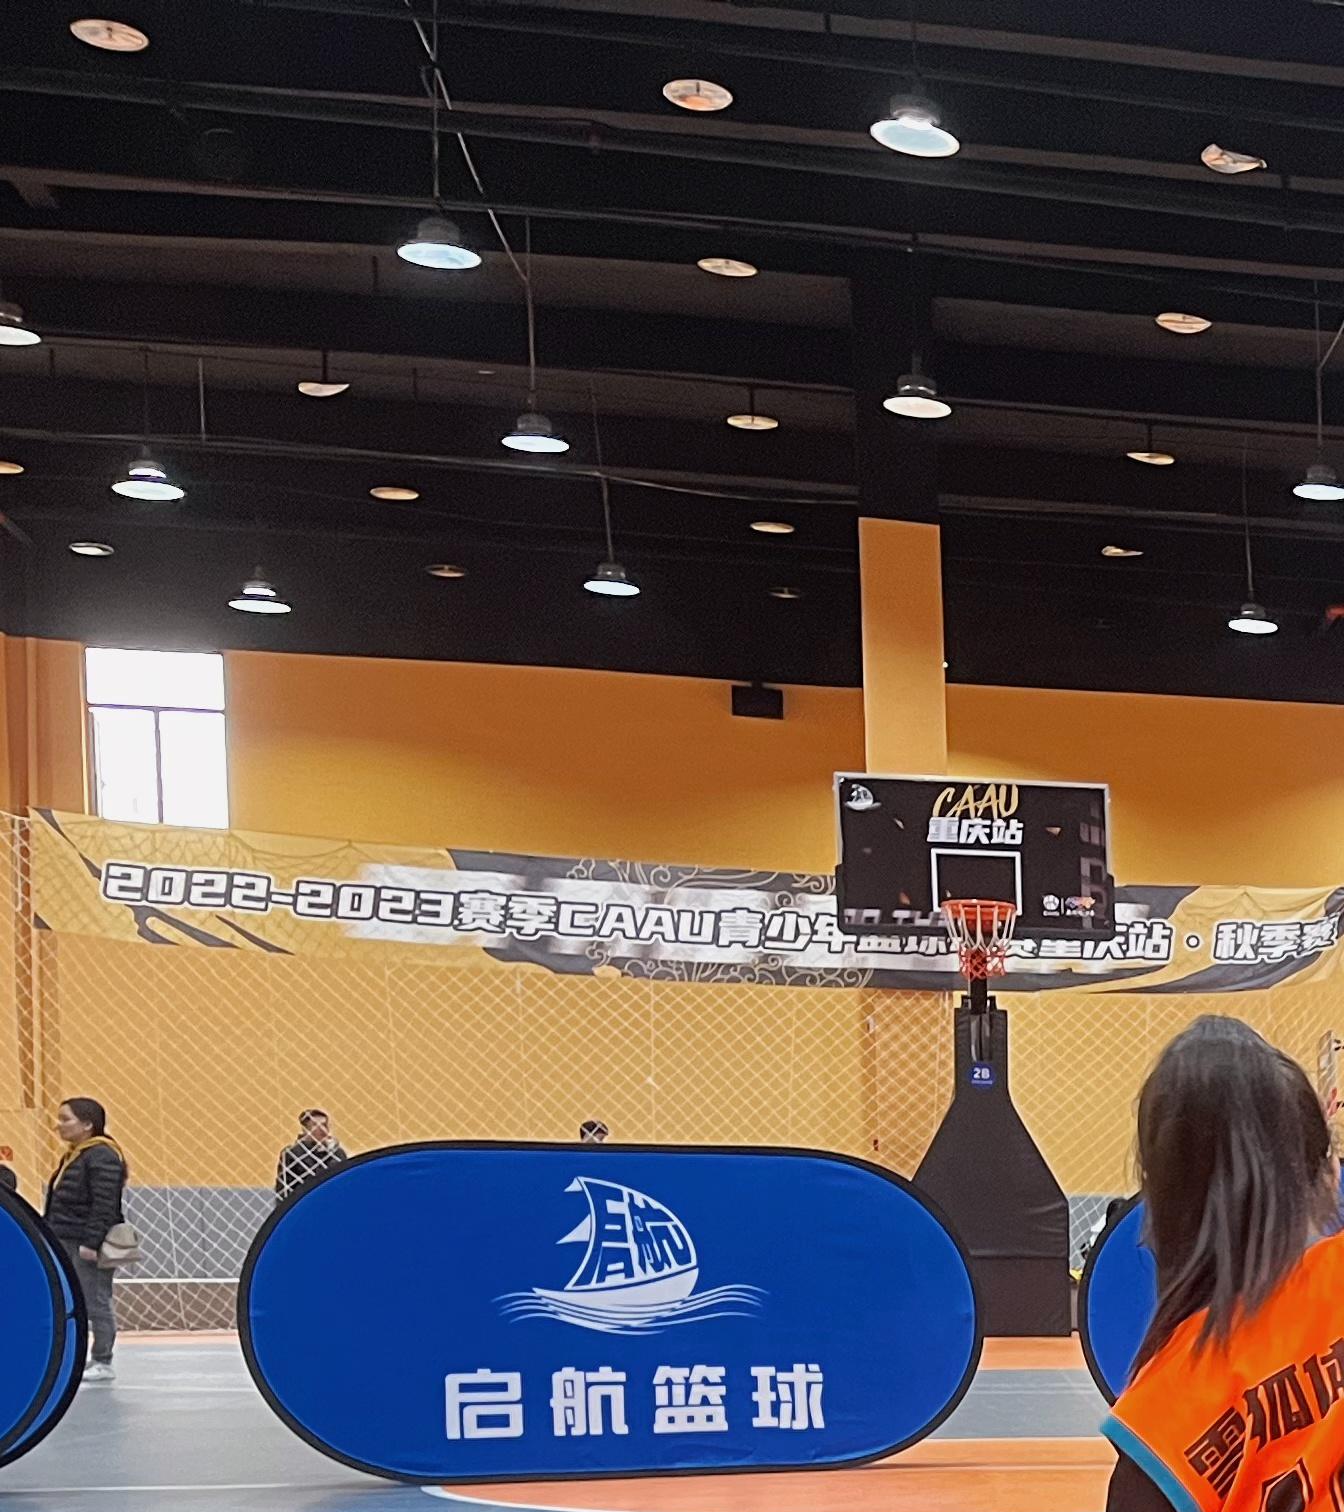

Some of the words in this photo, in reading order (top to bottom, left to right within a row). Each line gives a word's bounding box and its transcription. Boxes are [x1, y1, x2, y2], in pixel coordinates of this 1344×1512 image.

[931, 783, 1020, 824] CAAU
[926, 816, 1025, 846] 重庆站
[444, 1363, 826, 1440] 启航篮球
